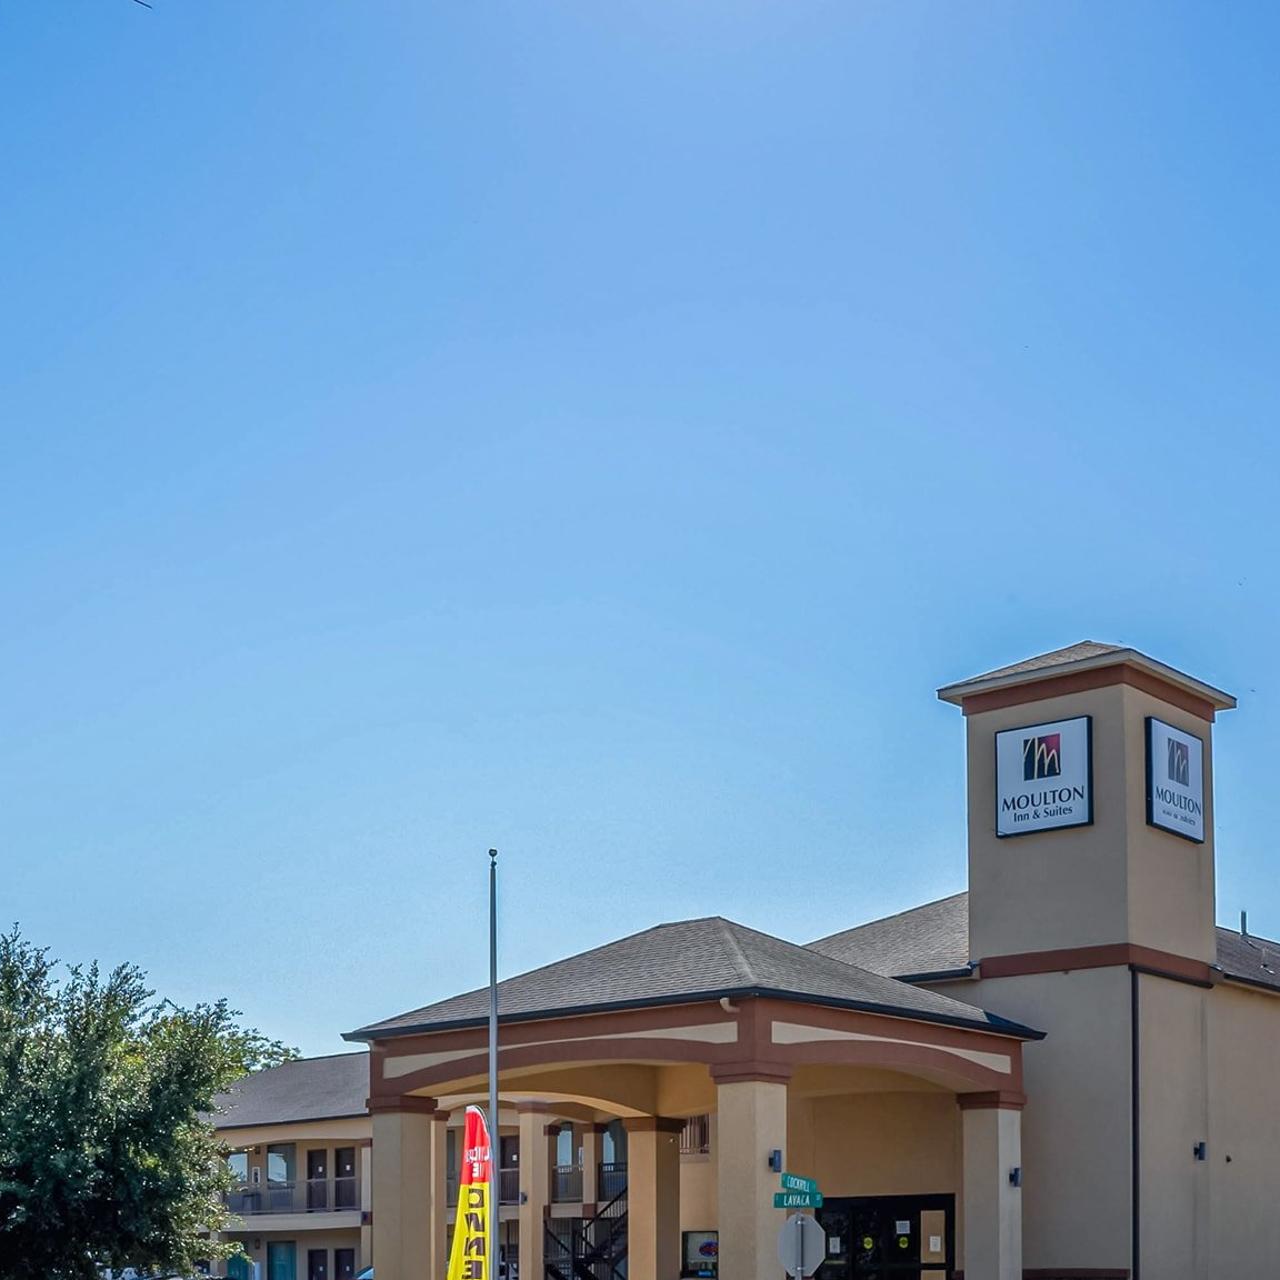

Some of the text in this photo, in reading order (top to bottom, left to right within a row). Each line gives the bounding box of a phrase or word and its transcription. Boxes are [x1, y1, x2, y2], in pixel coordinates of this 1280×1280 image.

[1002, 785, 1084, 812] MOULTON
[1156, 786, 1201, 816] MOULTON
[1014, 805, 1073, 822] Inn & Suites
[783, 1194, 810, 1206] LAVACA
